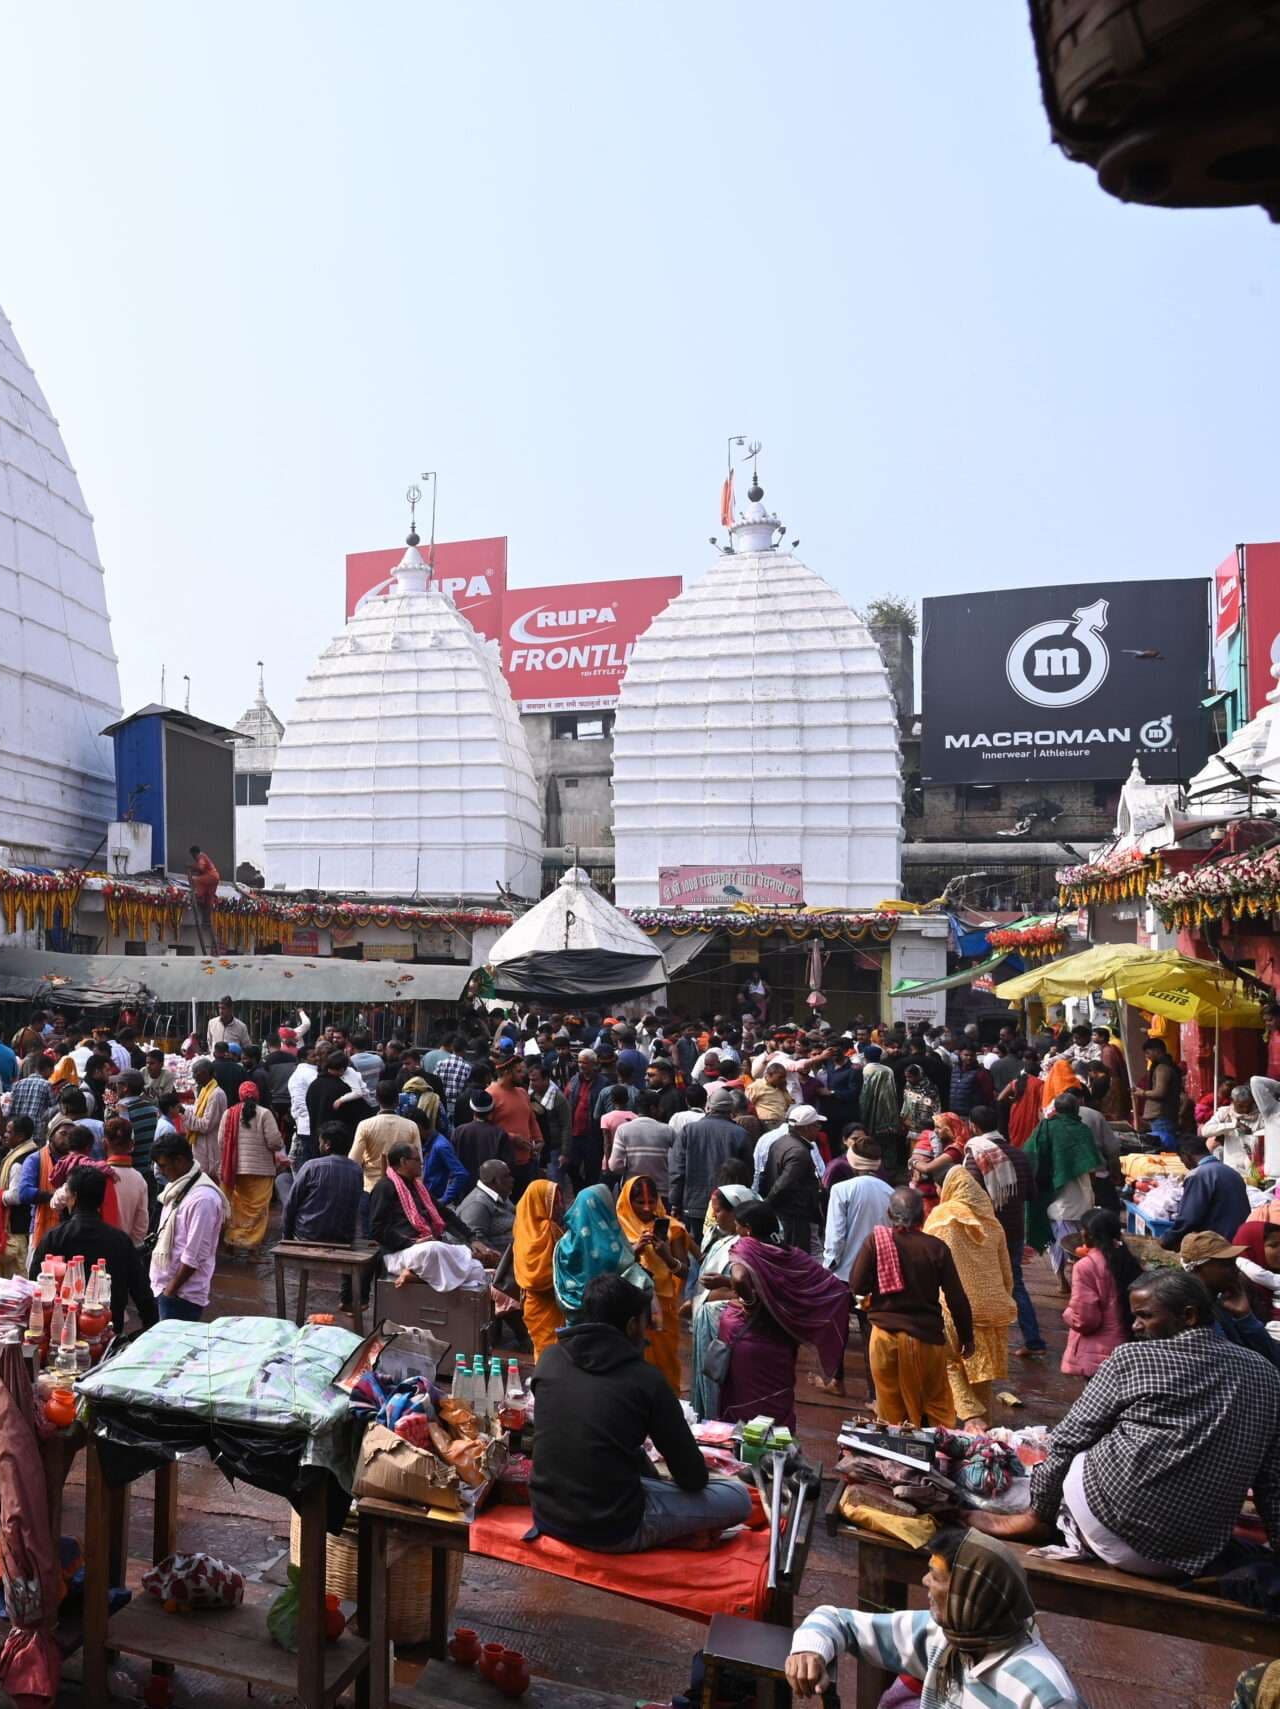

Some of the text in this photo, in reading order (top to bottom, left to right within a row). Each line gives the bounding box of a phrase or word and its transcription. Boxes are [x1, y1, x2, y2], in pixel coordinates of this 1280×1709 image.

[537, 607, 616, 628] RUPA
[509, 642, 636, 672] FRONTLI
[945, 727, 1131, 749] MACROMAN
[982, 751, 1031, 760] Innerwear
[1039, 748, 1091, 758] Athleisure
